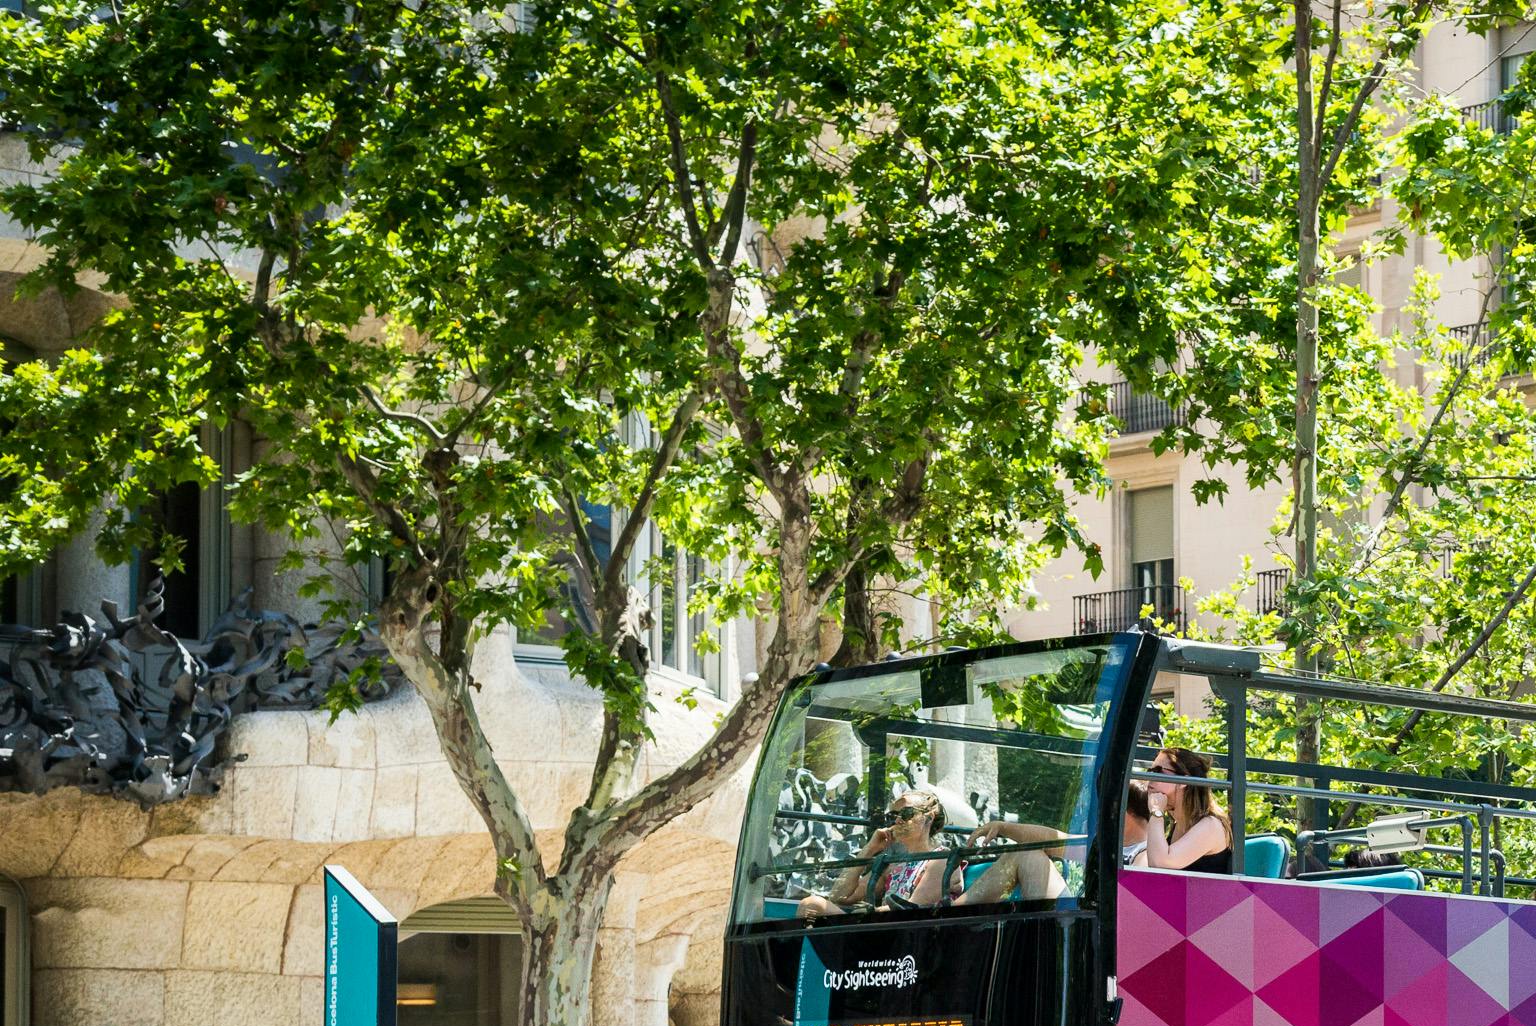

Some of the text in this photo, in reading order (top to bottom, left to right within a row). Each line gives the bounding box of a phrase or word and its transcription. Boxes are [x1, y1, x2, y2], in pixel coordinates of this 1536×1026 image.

[329, 895, 339, 975] BusTurístic
[858, 959, 896, 968] Worldwide
[823, 968, 904, 991] City Sightseeing
